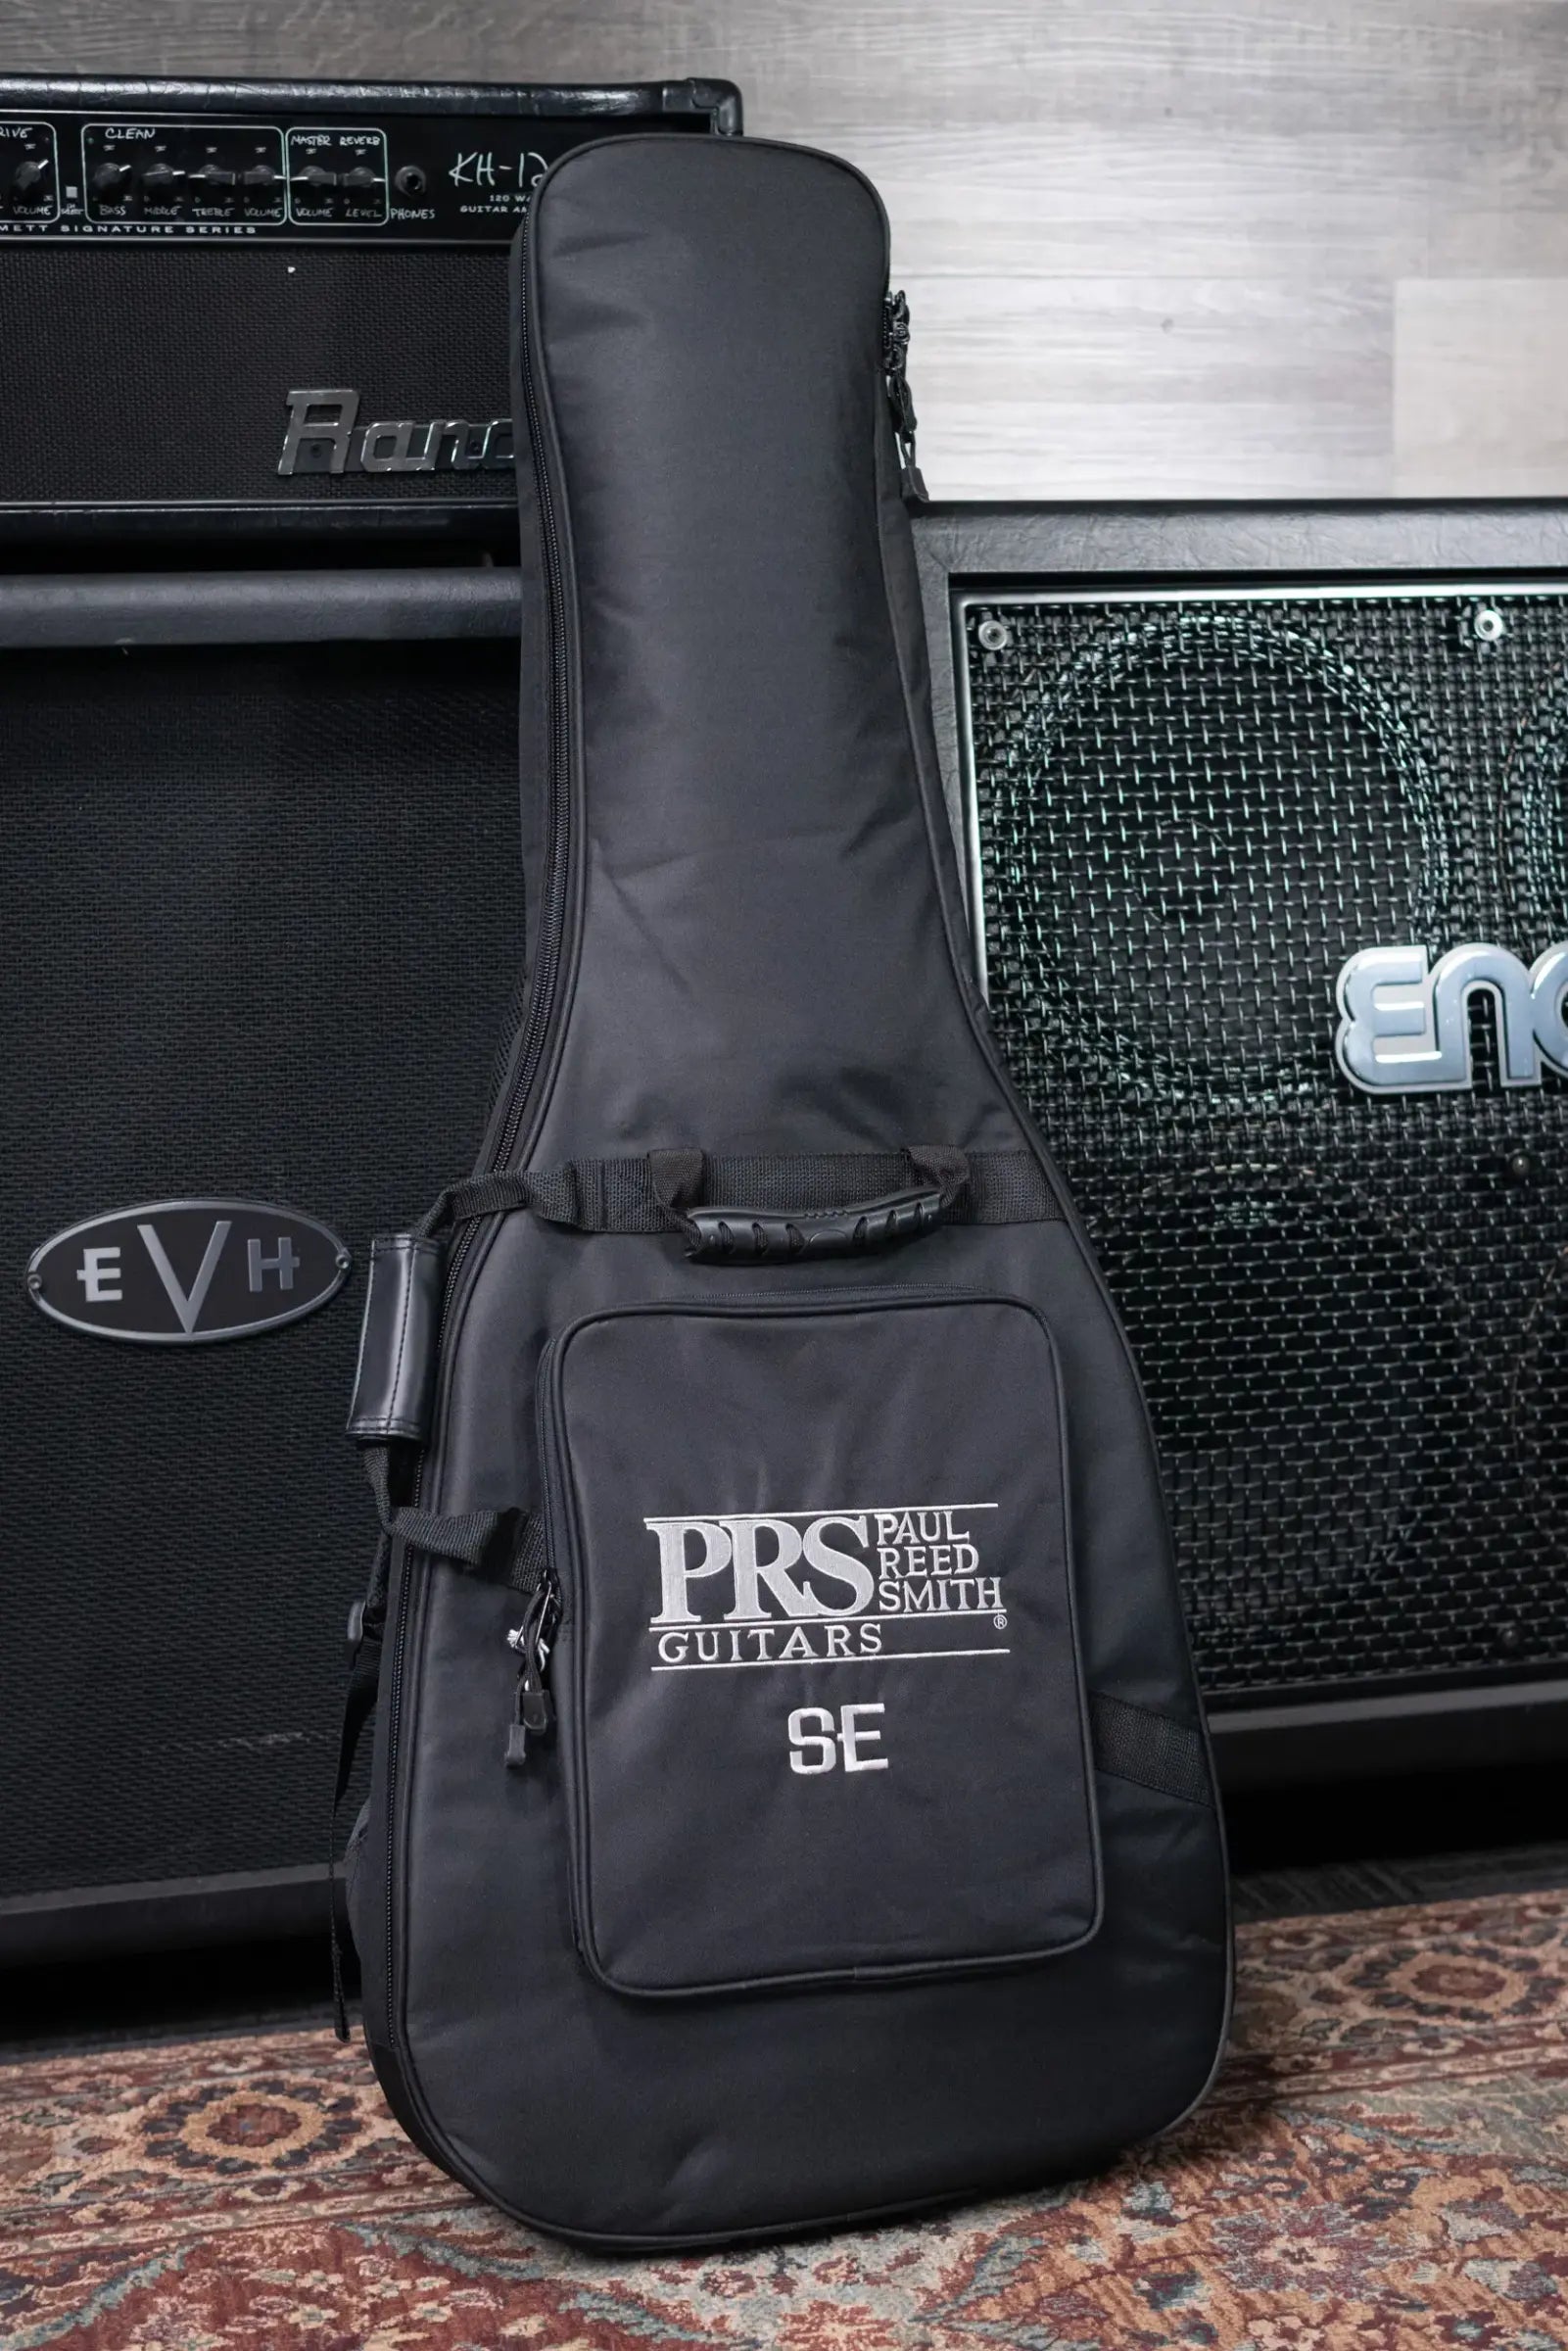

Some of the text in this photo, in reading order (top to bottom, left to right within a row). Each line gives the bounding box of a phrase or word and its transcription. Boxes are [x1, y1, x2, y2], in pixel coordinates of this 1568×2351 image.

[105, 128, 157, 140] CLEAN
[290, 134, 332, 146] MASTER
[339, 135, 380, 146] REVERB
[13, 205, 53, 216] VOLUME
[99, 204, 126, 216] BASS
[144, 206, 182, 216] MIDDLE
[192, 208, 235, 216] TREBLE
[244, 208, 282, 217] VOLUME
[296, 207, 333, 217] VOLUME
[346, 208, 382, 217] LEVEL
[390, 208, 435, 219] PHONES
[60, 224, 174, 233] SIGNATURE
[76, 1221, 300, 1334] EVH
[874, 1511, 970, 1545] PAUL
[876, 1543, 979, 1580] REED
[645, 1515, 875, 1623] PRS
[878, 1576, 1003, 1613] SMITH
[658, 1622, 882, 1663] GUITARS
[787, 1703, 888, 1775] SE
